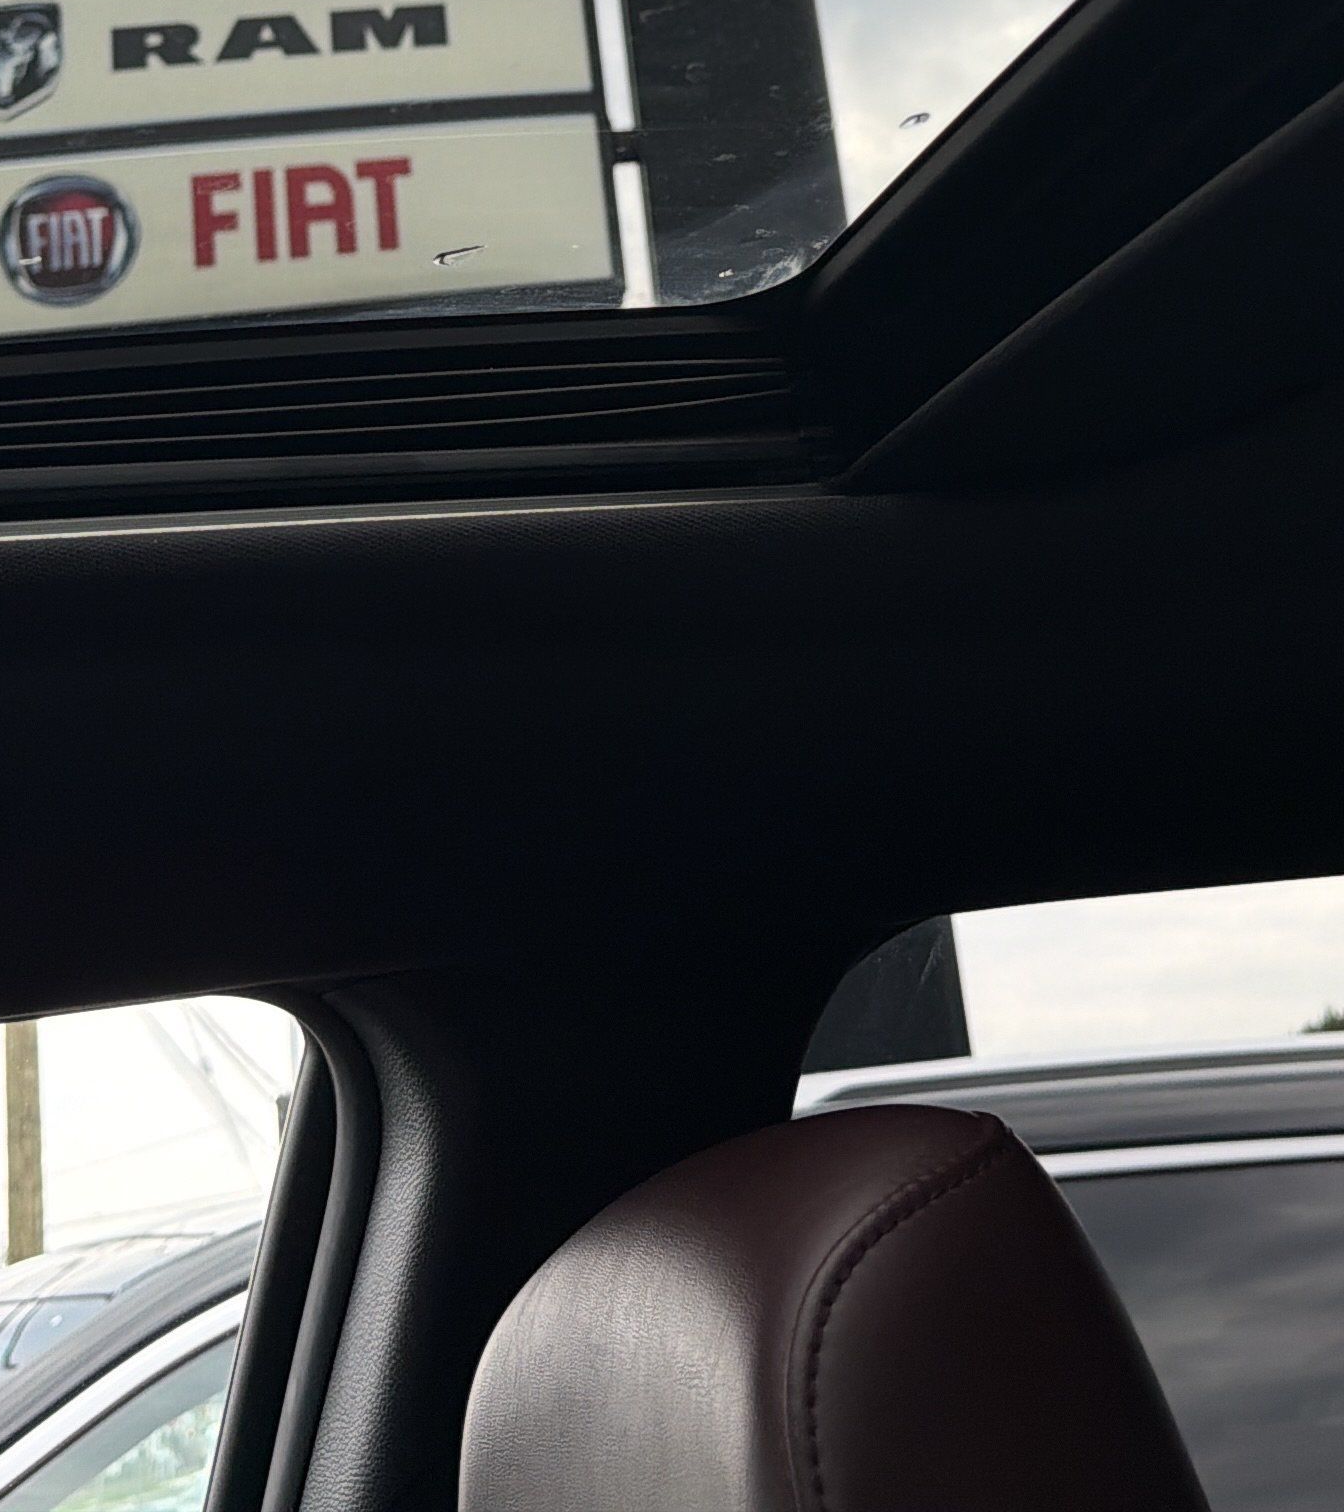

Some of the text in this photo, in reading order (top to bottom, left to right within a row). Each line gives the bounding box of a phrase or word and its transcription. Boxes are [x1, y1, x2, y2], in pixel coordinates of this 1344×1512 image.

[110, 3, 450, 71] RAM
[26, 205, 109, 272] FIAT
[189, 157, 413, 270] FIAT
